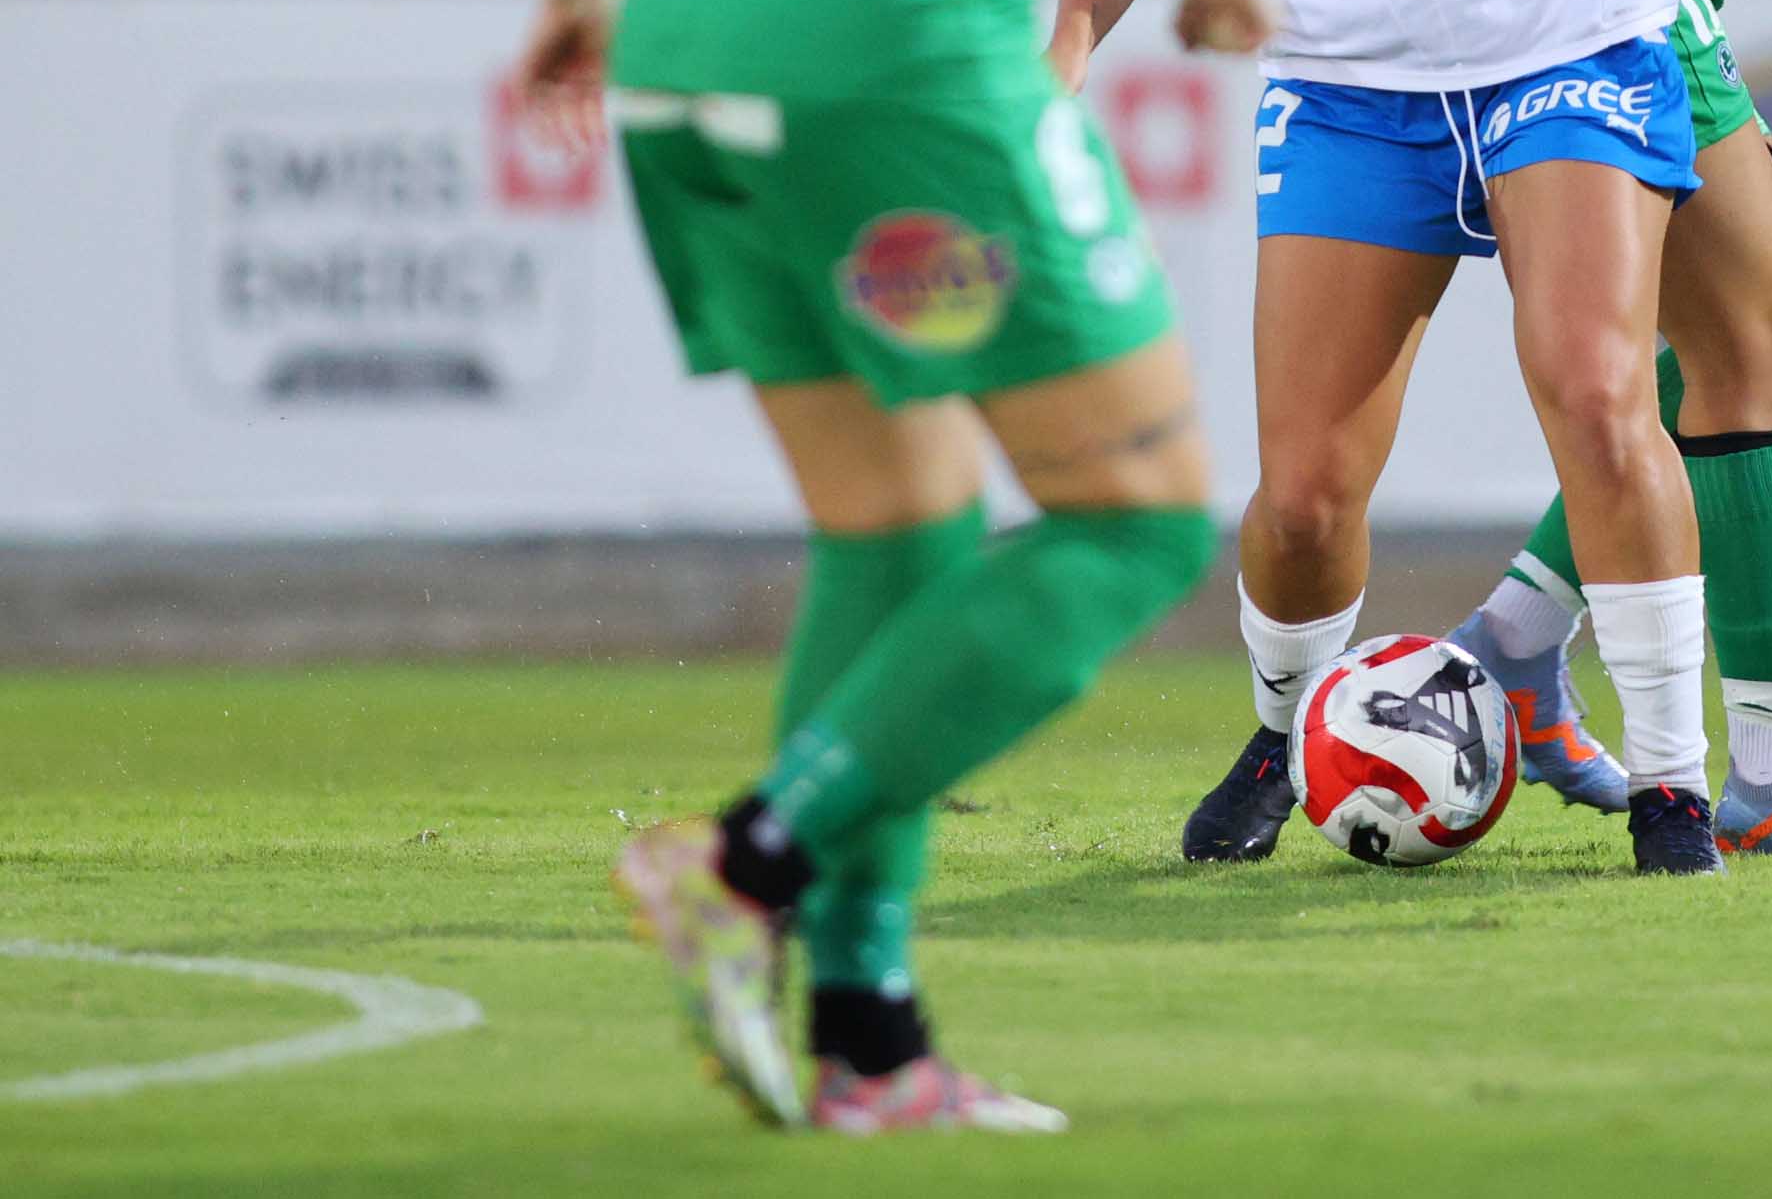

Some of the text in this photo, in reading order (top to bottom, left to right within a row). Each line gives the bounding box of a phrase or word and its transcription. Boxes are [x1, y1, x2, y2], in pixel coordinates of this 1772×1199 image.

[1516, 79, 1654, 122] GREE
[219, 133, 468, 214] SWISS
[219, 247, 543, 321] ENERGY
